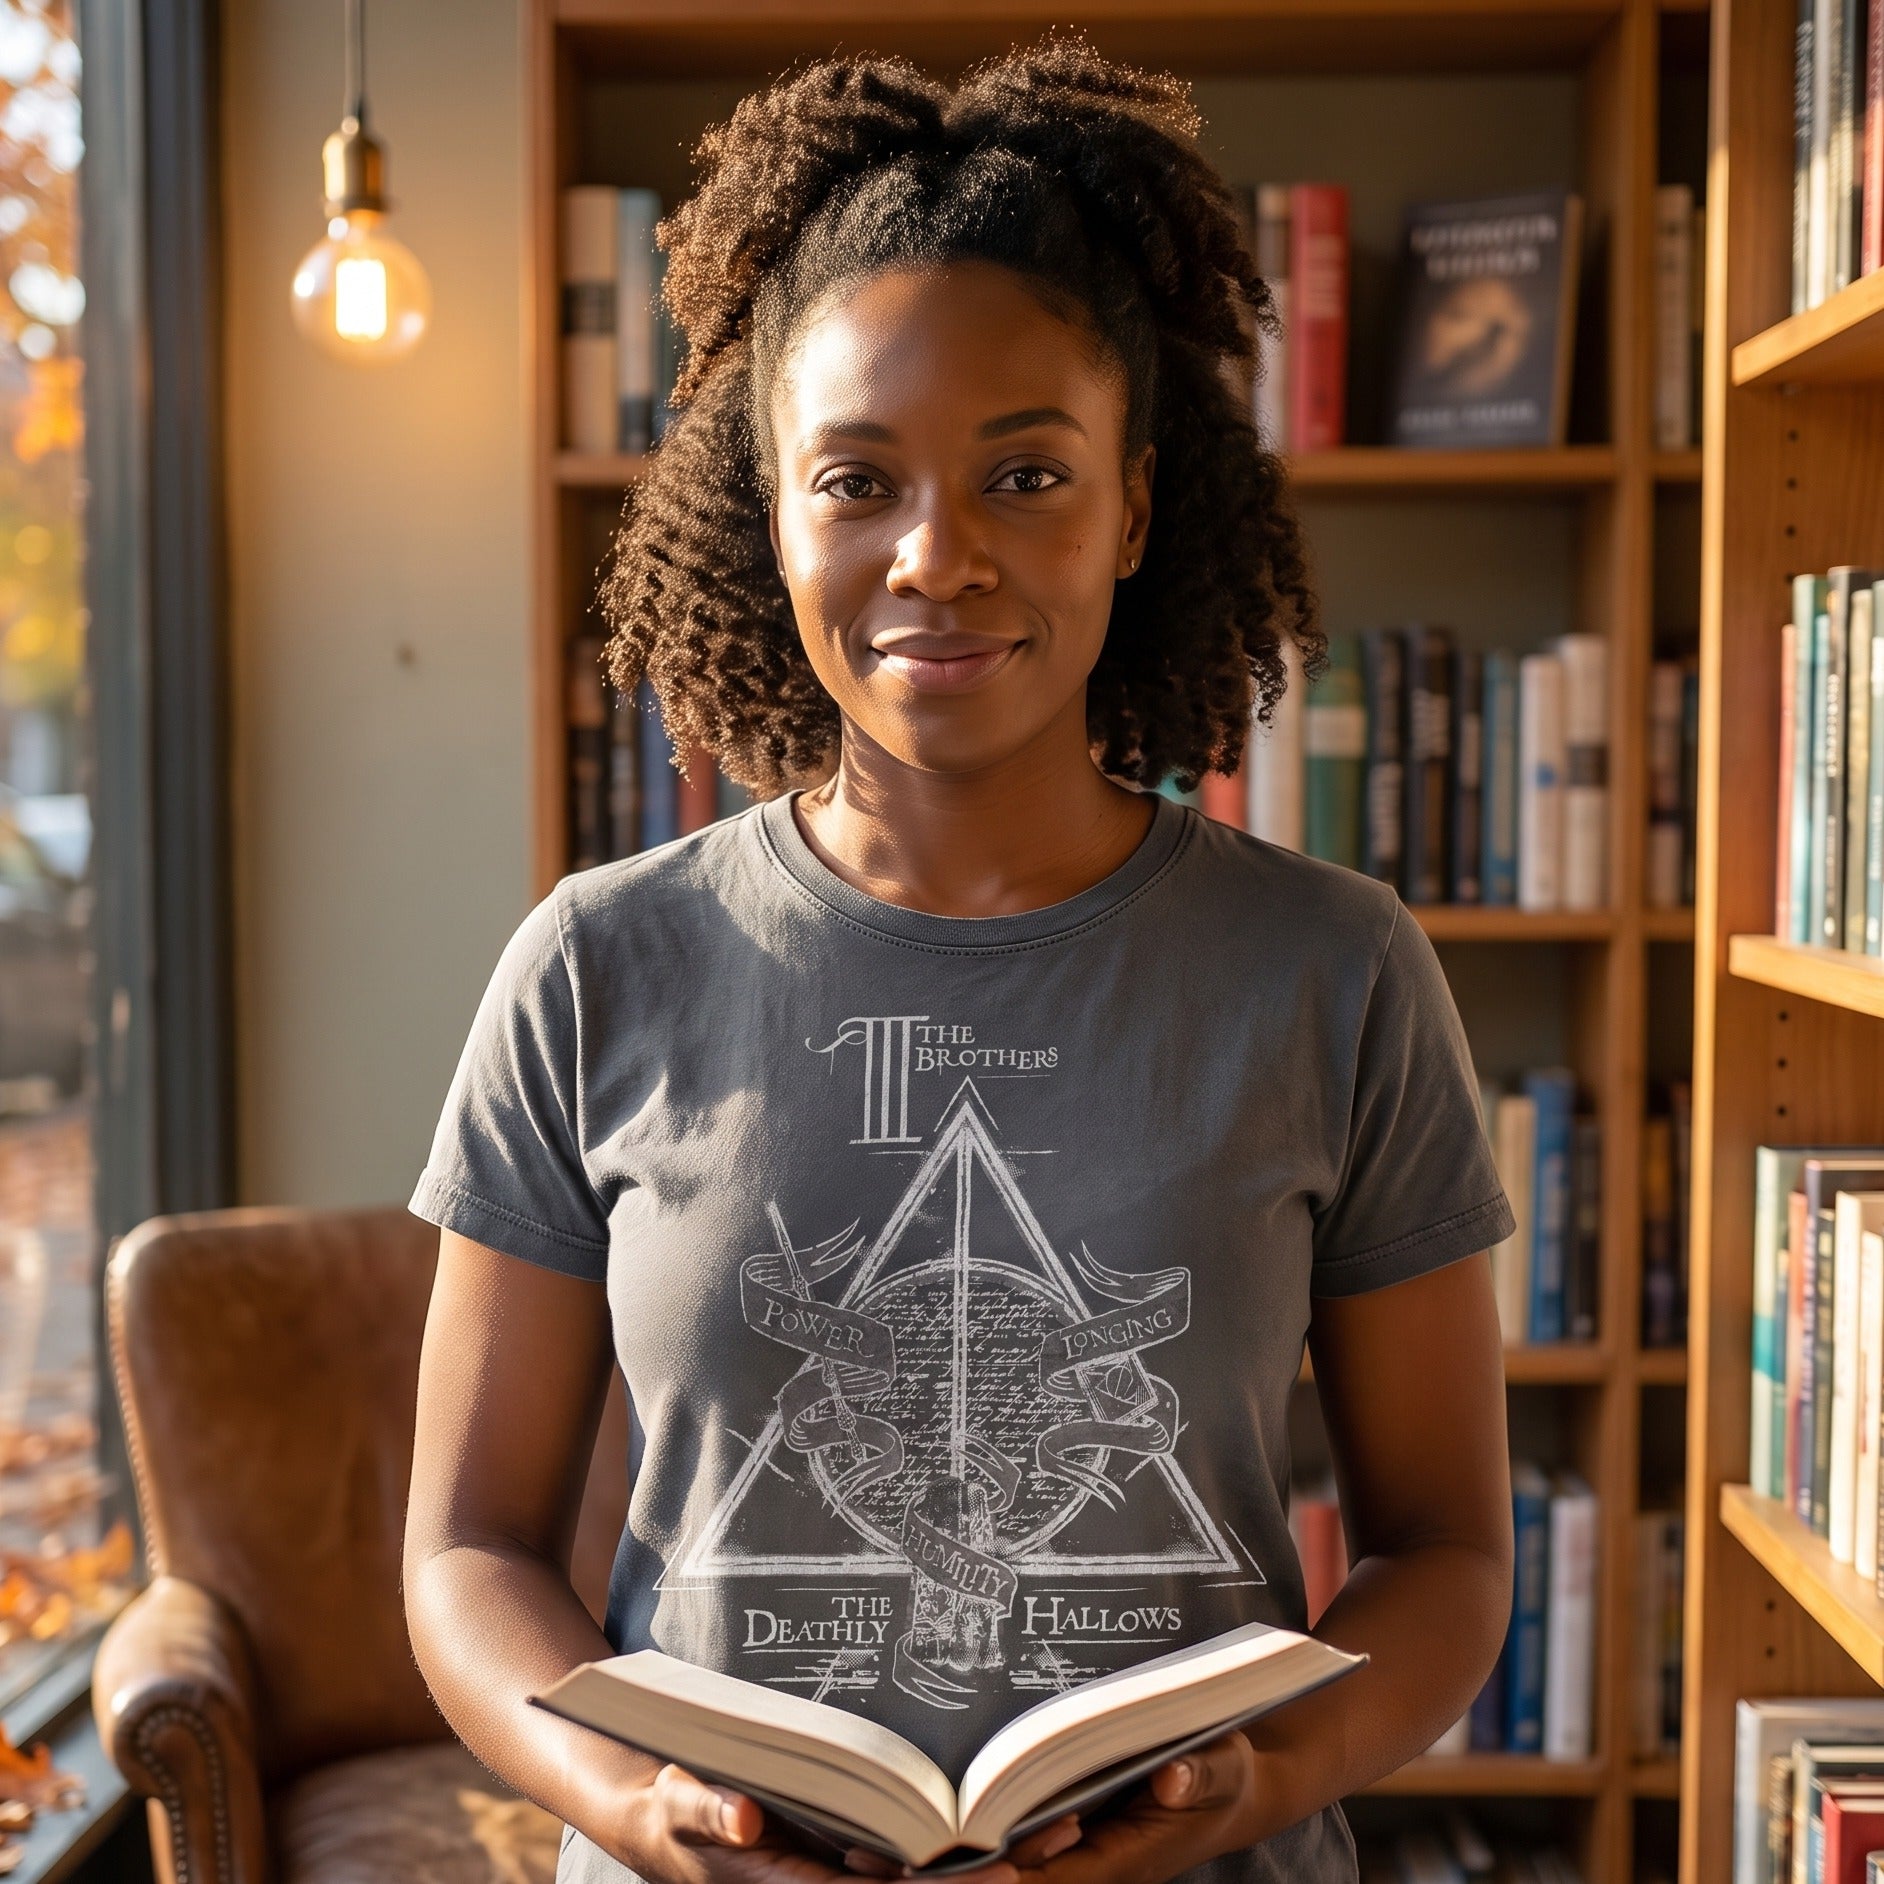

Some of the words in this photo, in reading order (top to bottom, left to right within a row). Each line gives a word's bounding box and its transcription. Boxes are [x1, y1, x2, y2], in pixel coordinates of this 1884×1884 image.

[916, 1025, 975, 1044] THE
[915, 1047, 1058, 1073] BROTHERS
[760, 1297, 875, 1358] POWER
[1060, 1308, 1172, 1360] LONGING
[905, 1525, 1009, 1597] HUMILITY
[742, 1609, 890, 1647] DEATHLY
[1021, 1597, 1182, 1635] HALLOWS
[831, 1597, 893, 1618] THE
